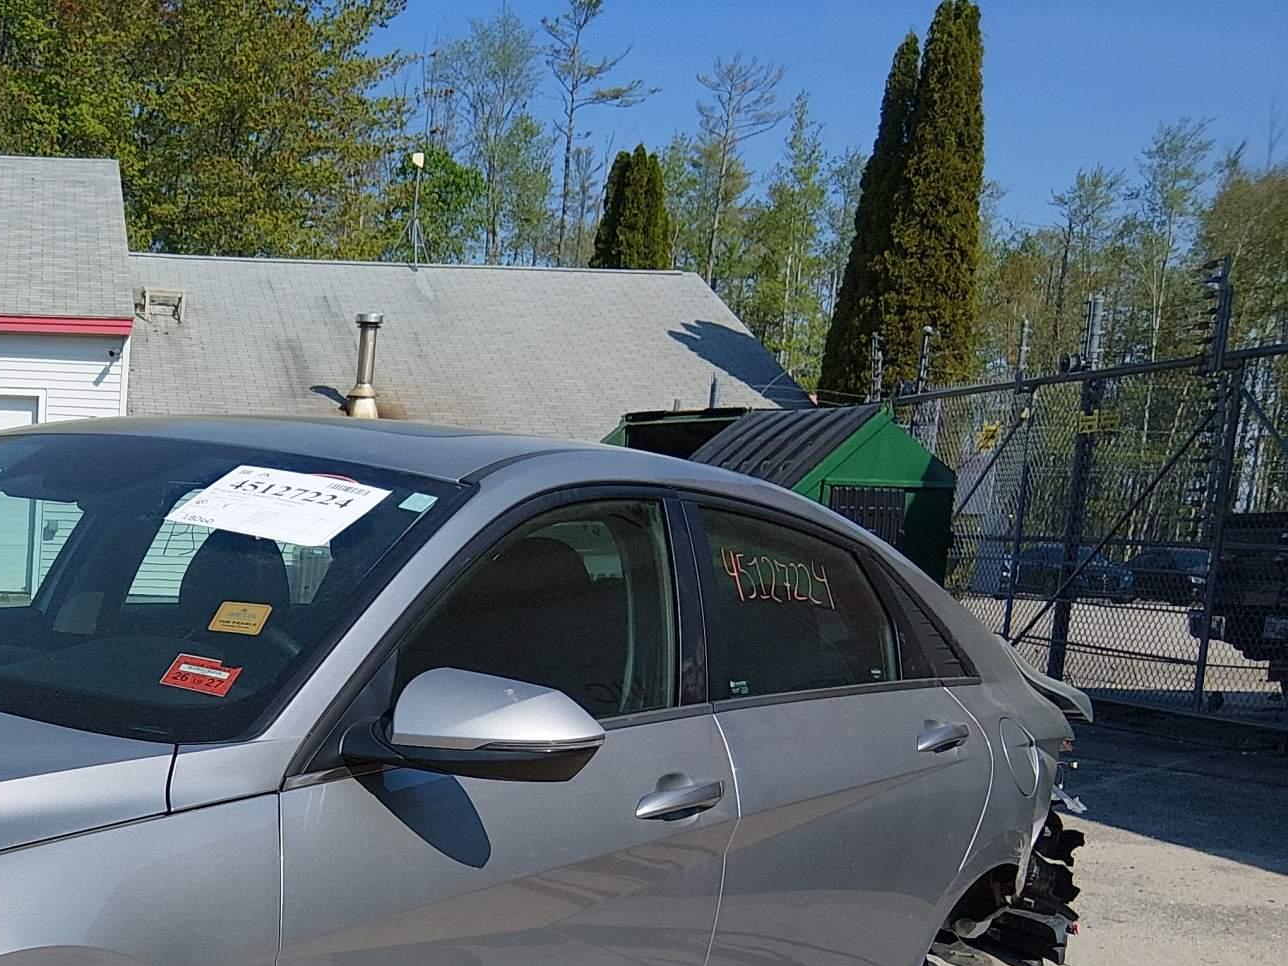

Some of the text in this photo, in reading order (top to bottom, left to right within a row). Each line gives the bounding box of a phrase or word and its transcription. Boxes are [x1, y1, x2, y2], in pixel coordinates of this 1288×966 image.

[229, 479, 355, 509] 45127224
[721, 547, 836, 611] 45127224
[172, 671, 189, 682] 26
[205, 678, 224, 689] 27
